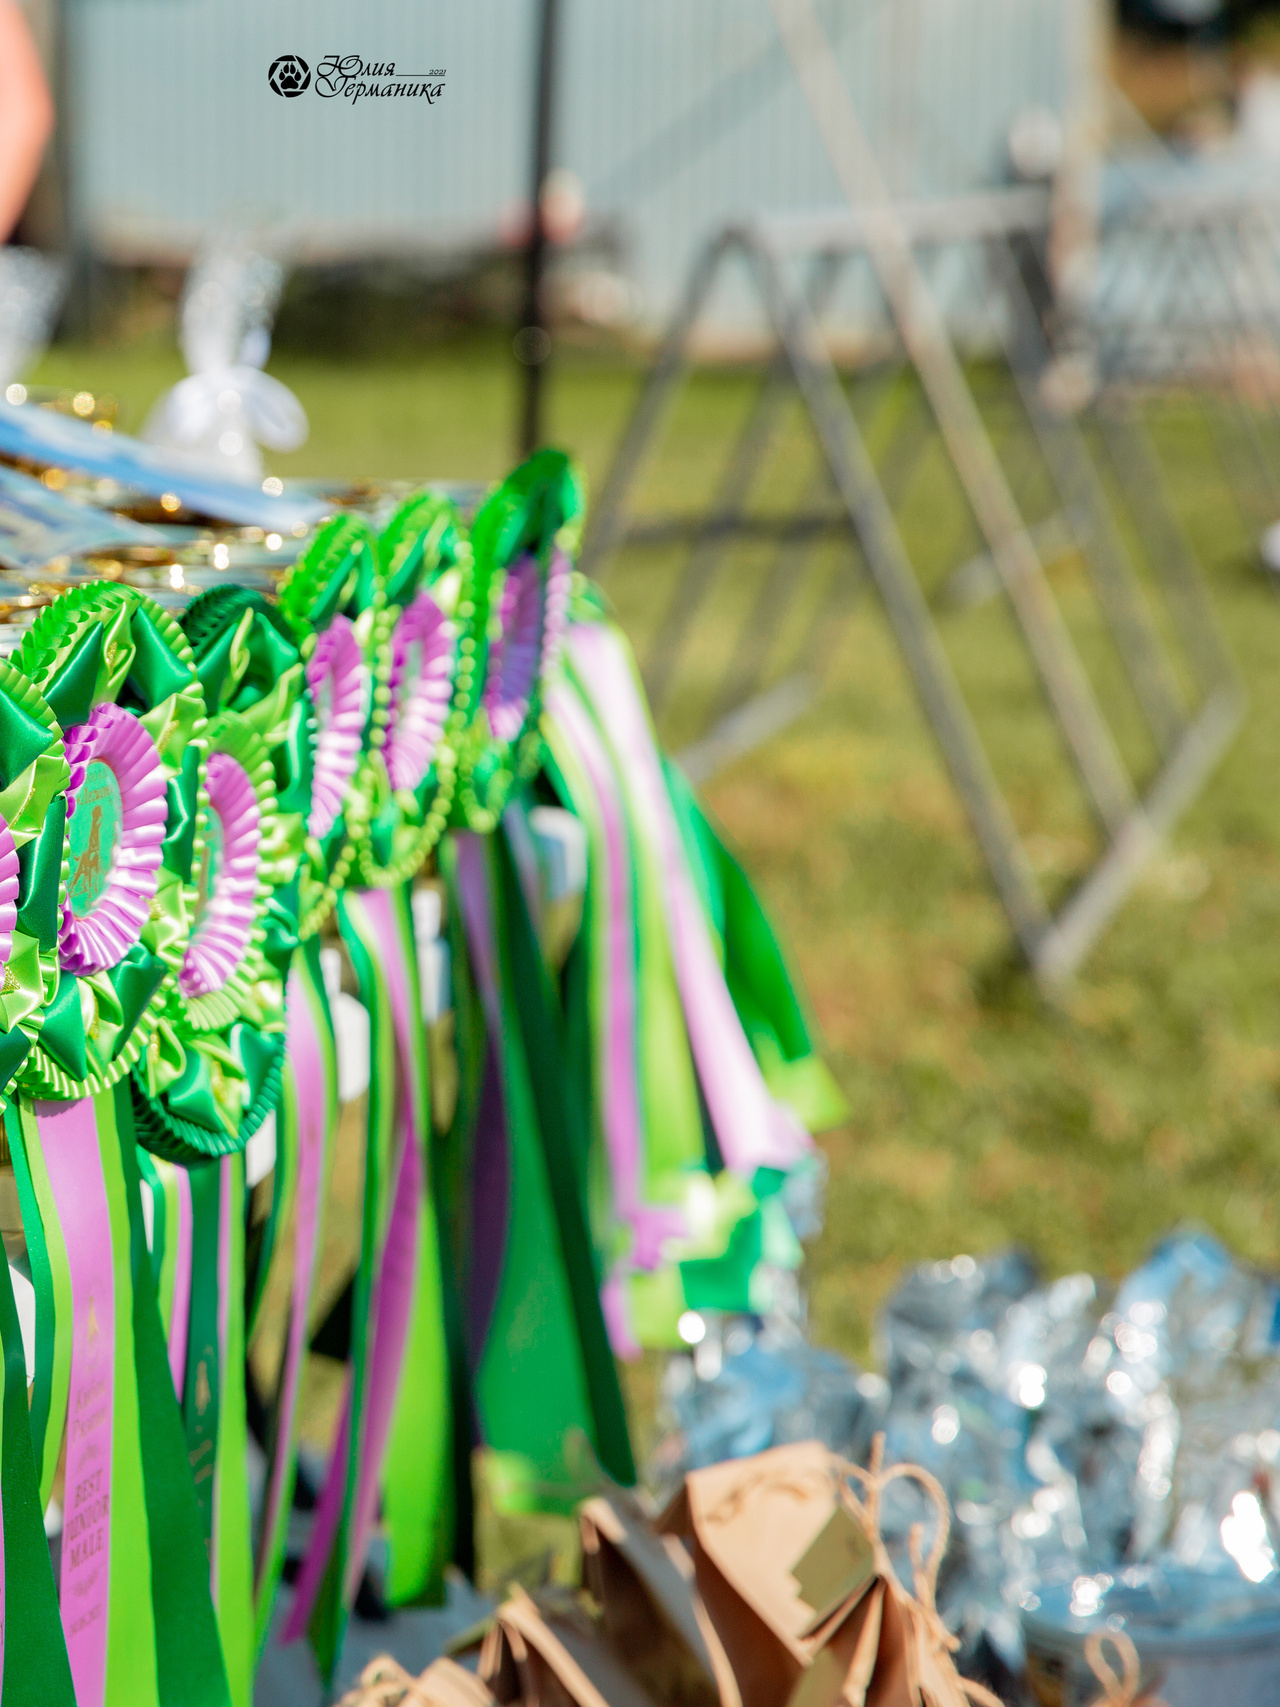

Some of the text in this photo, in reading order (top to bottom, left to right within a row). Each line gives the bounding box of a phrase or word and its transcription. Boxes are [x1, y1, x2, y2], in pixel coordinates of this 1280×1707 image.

[75, 1468, 103, 1508] BEST
[63, 1494, 110, 1553] JUNIOR
[69, 1528, 104, 1572] MALE
